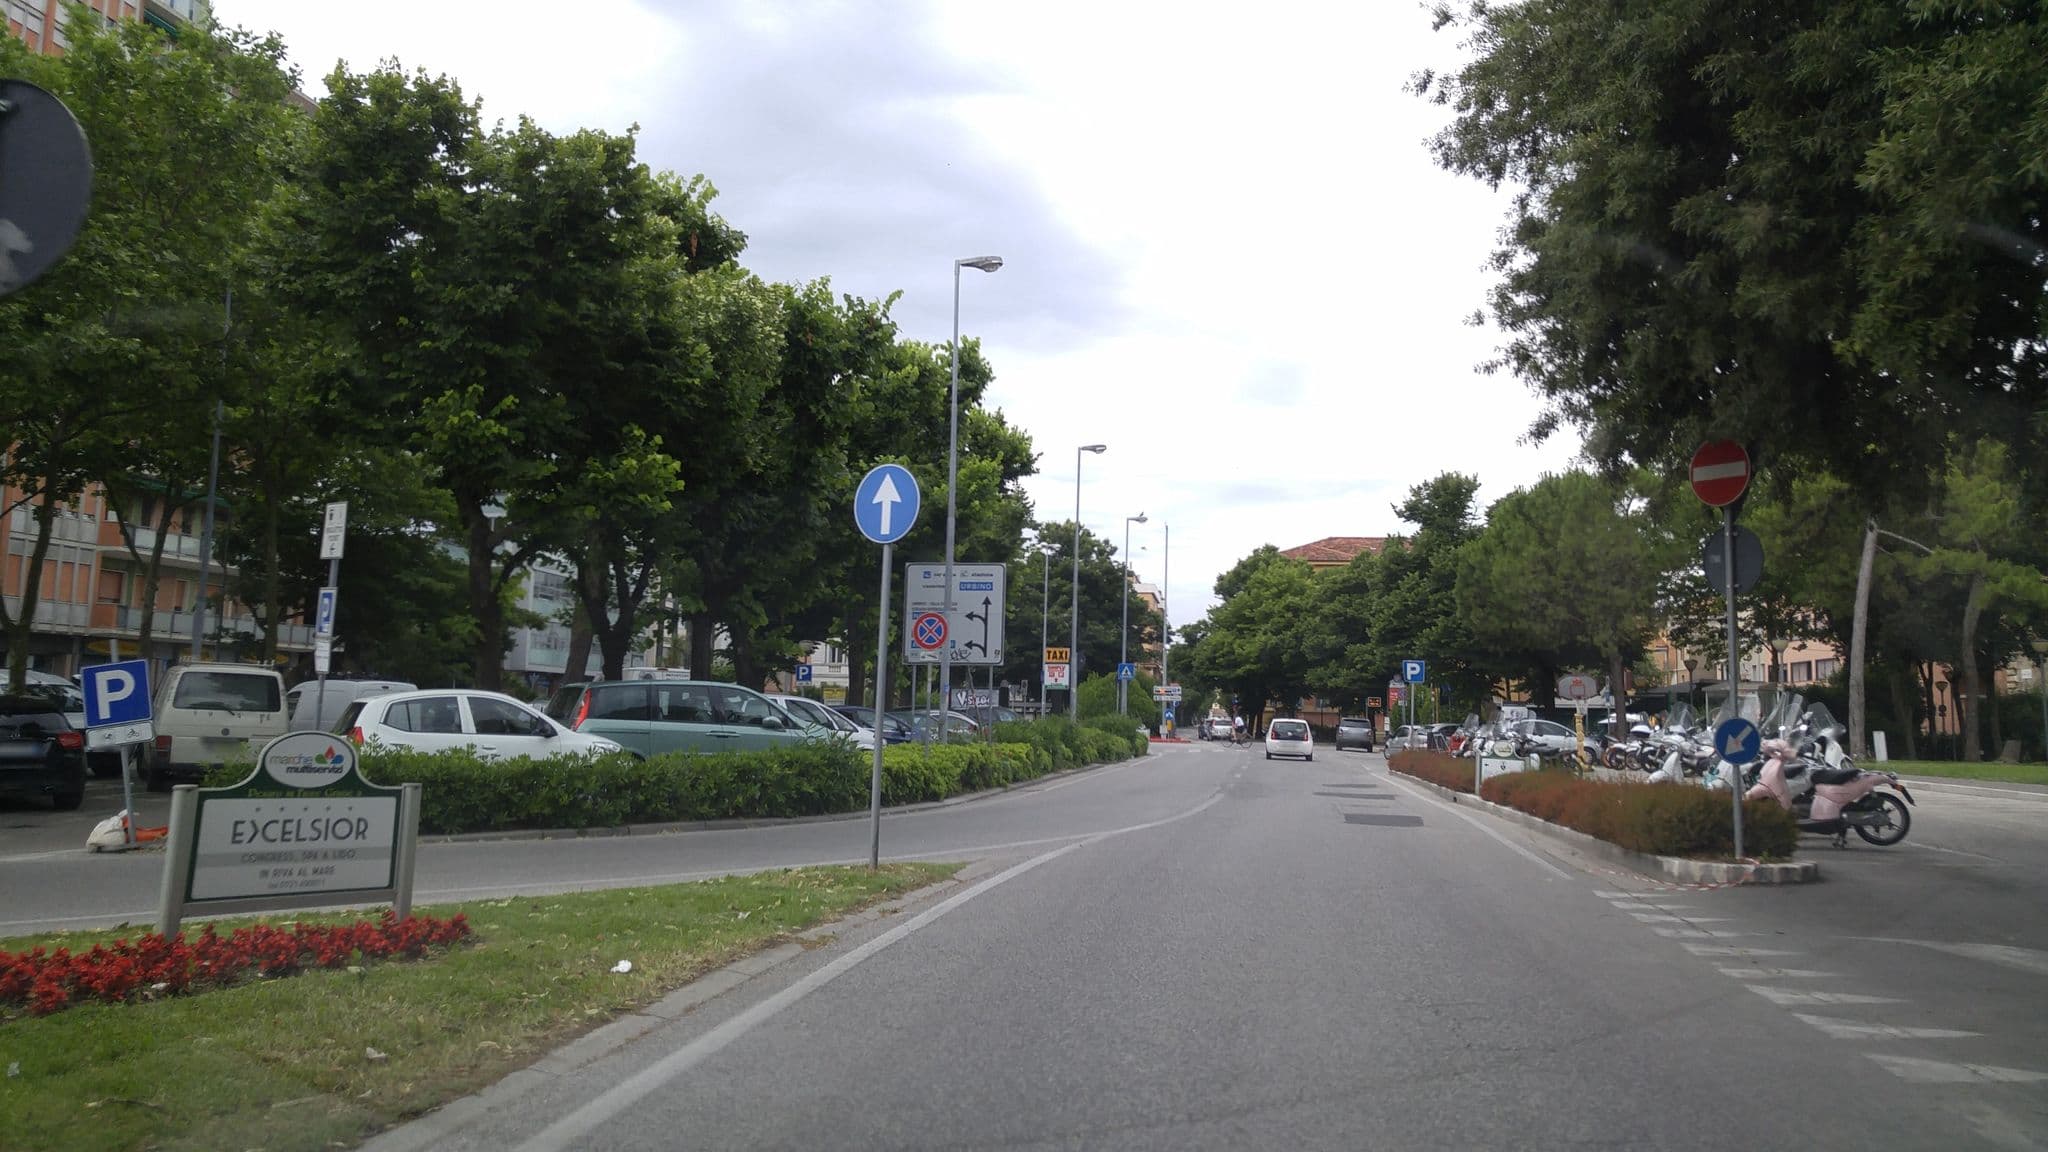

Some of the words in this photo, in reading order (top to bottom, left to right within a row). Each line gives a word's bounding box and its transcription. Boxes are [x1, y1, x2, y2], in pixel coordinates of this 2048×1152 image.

[1046, 650, 1068, 660] TAXI
[799, 666, 809, 680] P
[1406, 662, 1421, 680] P
[95, 669, 135, 720] P
[270, 753, 313, 765] marche
[231, 817, 369, 844] EXCELSIOR
